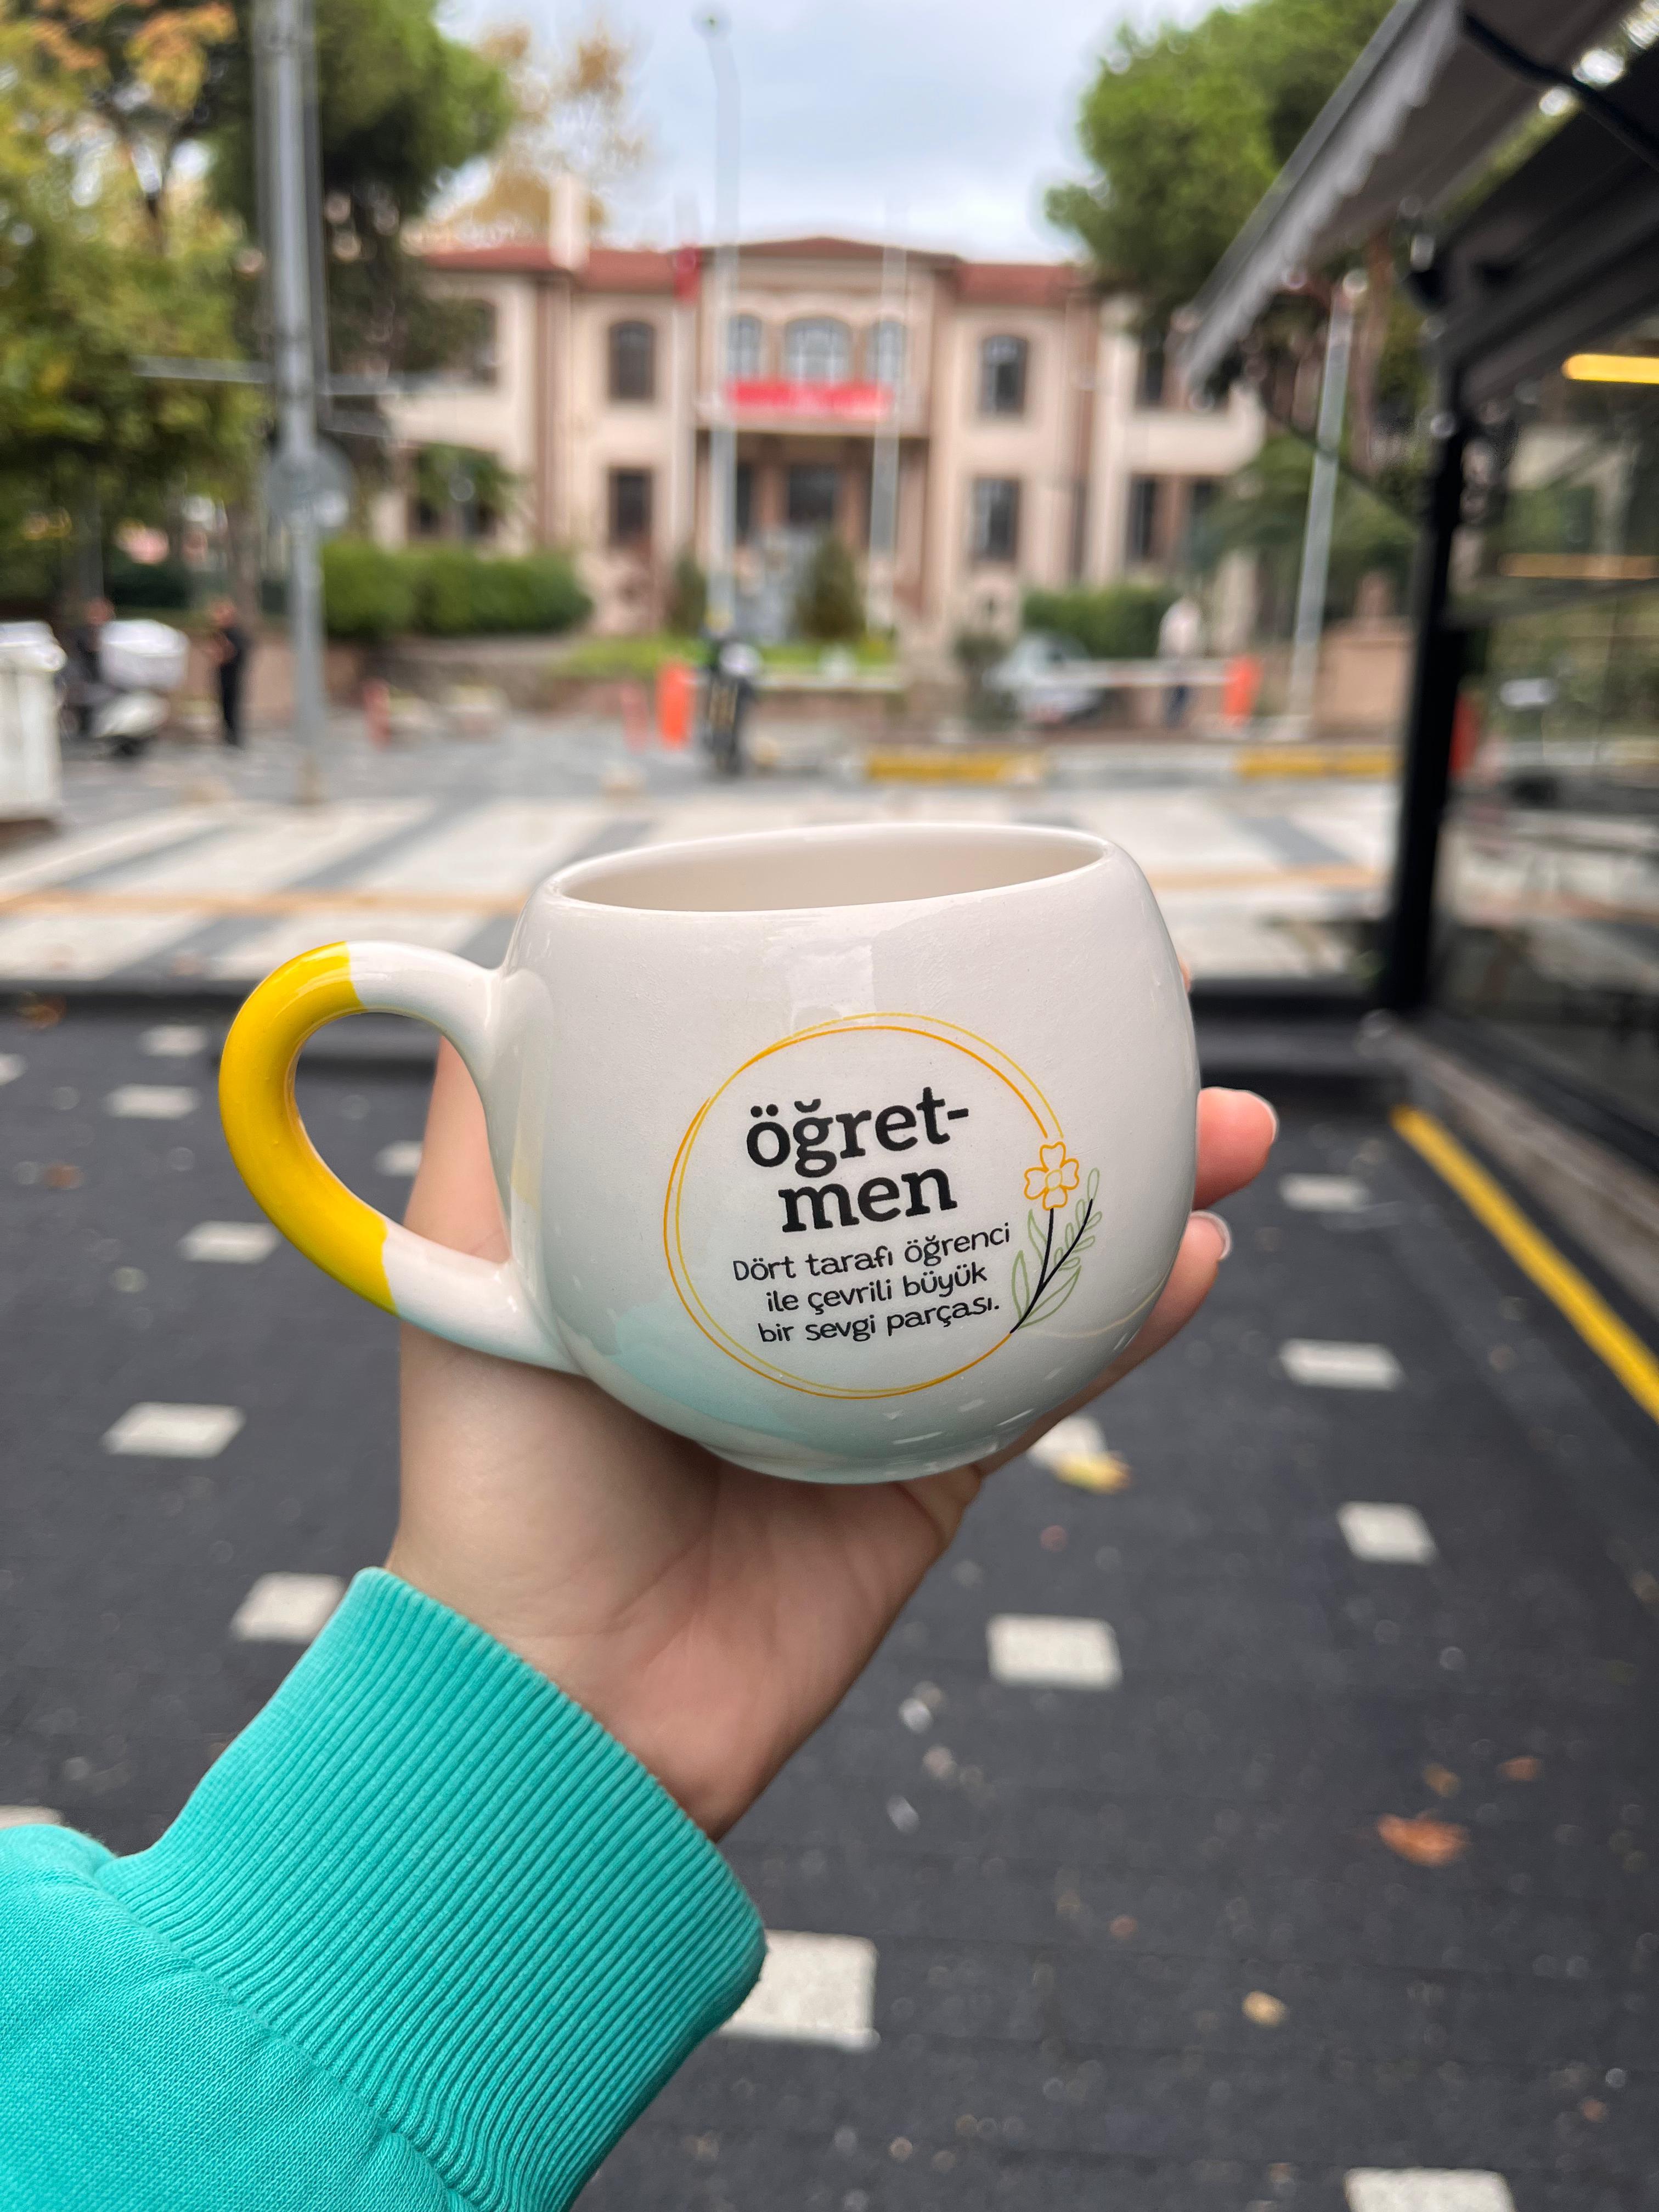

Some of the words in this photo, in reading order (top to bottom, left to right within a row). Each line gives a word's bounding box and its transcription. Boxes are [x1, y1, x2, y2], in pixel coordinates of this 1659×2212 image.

[746, 1086, 969, 1178] öğret-
[778, 1168, 958, 1233] men
[732, 1256, 797, 1281] Dört
[804, 1245, 893, 1277] tarafı
[904, 1222, 1010, 1266] öğrenci
[766, 1290, 799, 1312] ile
[808, 1278, 892, 1316] çevrili
[902, 1261, 988, 1298] büyük
[757, 1323, 794, 1342] bir
[805, 1314, 876, 1342] sevgi
[887, 1297, 1000, 1337] parçası.
